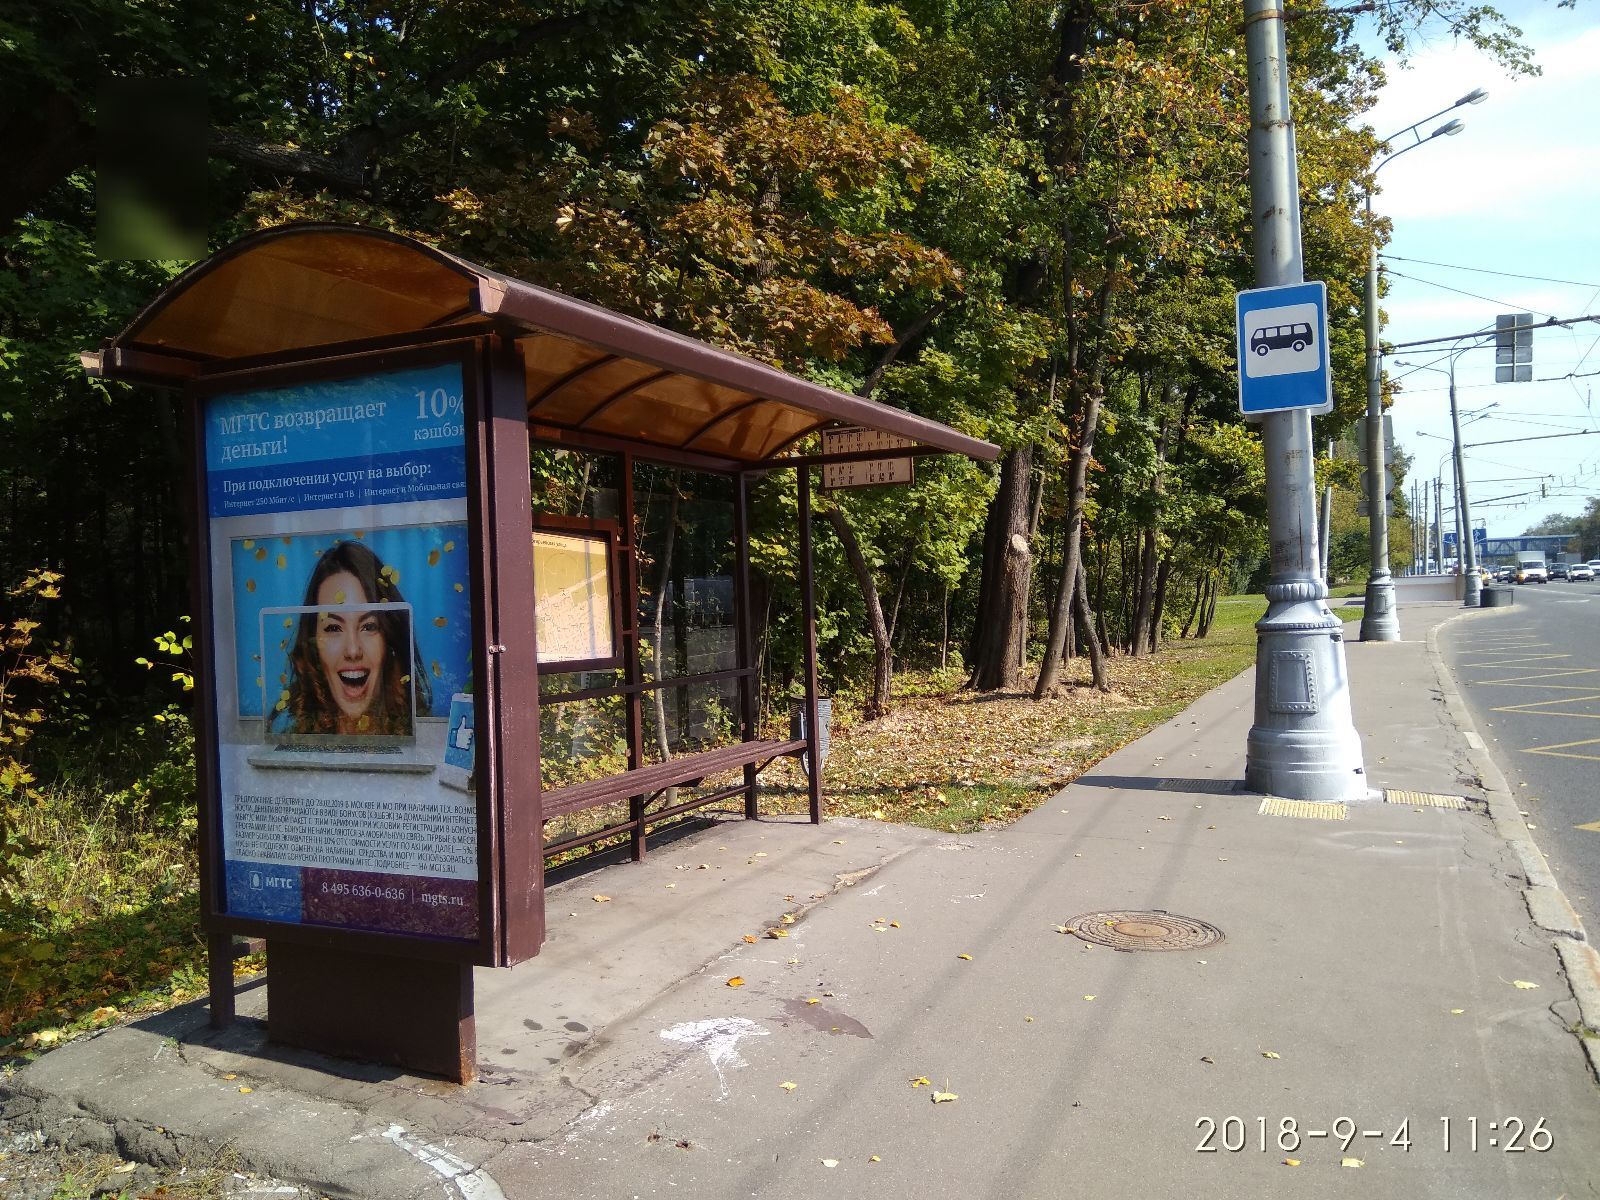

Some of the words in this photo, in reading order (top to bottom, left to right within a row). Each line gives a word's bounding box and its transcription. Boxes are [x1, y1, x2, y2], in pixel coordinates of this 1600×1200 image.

[414, 388, 464, 420] 10%
[220, 412, 270, 435] МГТС
[273, 402, 386, 430] возвращает
[221, 435, 287, 464] деньги!
[223, 480, 246, 495] При
[248, 473, 330, 491] подключении
[332, 470, 365, 486] услуг
[367, 468, 383, 480] на
[386, 462, 431, 478] выбор:
[223, 500, 255, 509] Интернет
[255, 497, 268, 506] 250
[304, 493, 337, 502] Интернет
[345, 490, 355, 498] ТВ
[364, 487, 400, 497] Интернет
[408, 482, 450, 493] Мобильная
[306, 799, 314, 807] ДО
[351, 801, 375, 810] МОСКВЕ
[394, 802, 406, 811] ПРИ
[408, 803, 438, 813] НАЛИЧИИ
[340, 810, 366, 819] БОНУСОВ
[396, 813, 402, 821] ЗА
[404, 813, 441, 823] ДОМАШНИЙ
[402, 823, 444, 833] РЕГИСТРАЦИИ
[266, 877, 293, 889] МГТС
[321, 882, 329, 893] 8
[330, 883, 350, 895] 495
[351, 885, 405, 900] 636-0-636
[421, 892, 464, 907] mgts.ru
